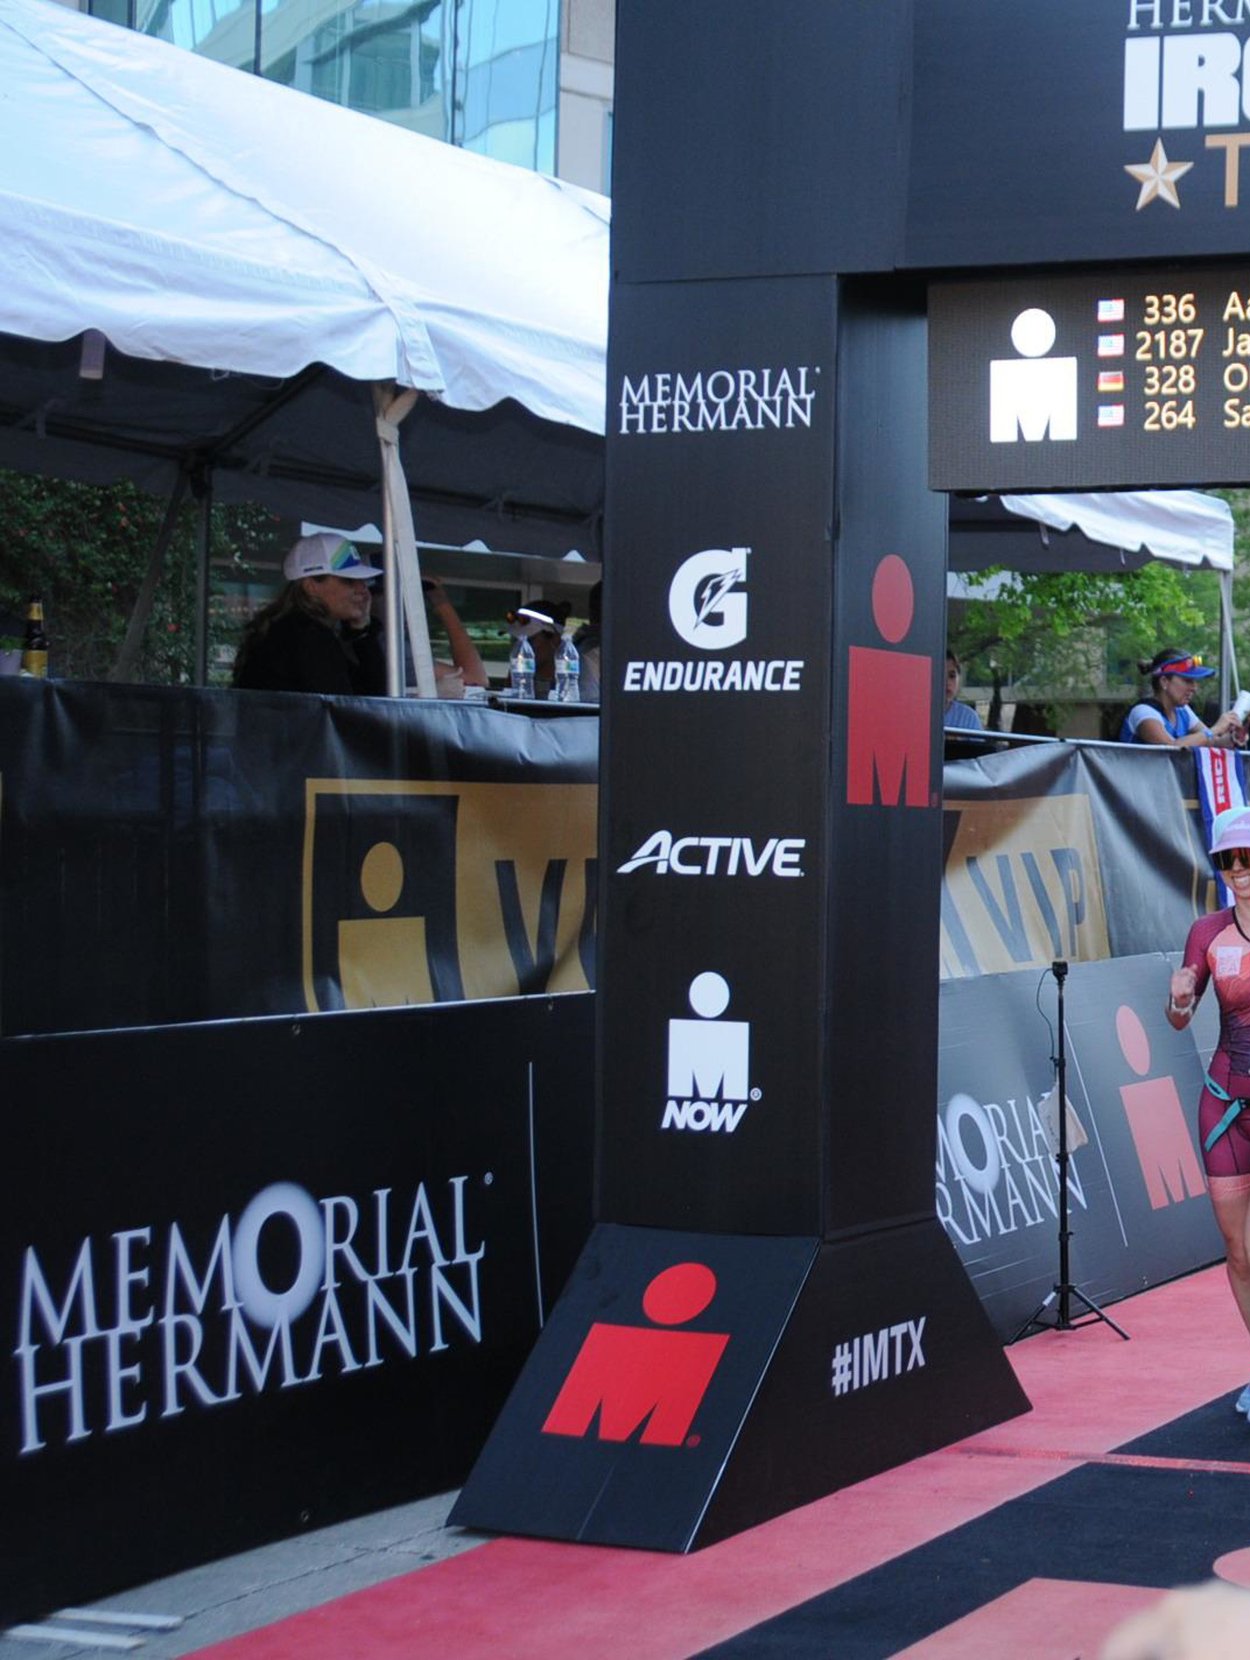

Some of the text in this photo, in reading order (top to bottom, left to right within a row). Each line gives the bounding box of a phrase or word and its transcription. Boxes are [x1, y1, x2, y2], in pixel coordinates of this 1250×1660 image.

[1144, 293, 1196, 325] 336
[1135, 328, 1204, 360] 2187
[620, 367, 815, 406] MEMORIAL
[1144, 365, 1196, 396] 328
[620, 396, 811, 433] HERMANN
[1143, 400, 1196, 431] 264
[623, 660, 804, 692] ENDURANCE
[617, 830, 806, 877] ACTIVE
[966, 848, 1086, 962] VIP
[660, 1100, 747, 1133] NOW
[13, 1175, 486, 1354] MEMORIAL
[14, 1254, 484, 1456] HERMANN
[831, 1316, 926, 1397] #IMTX
